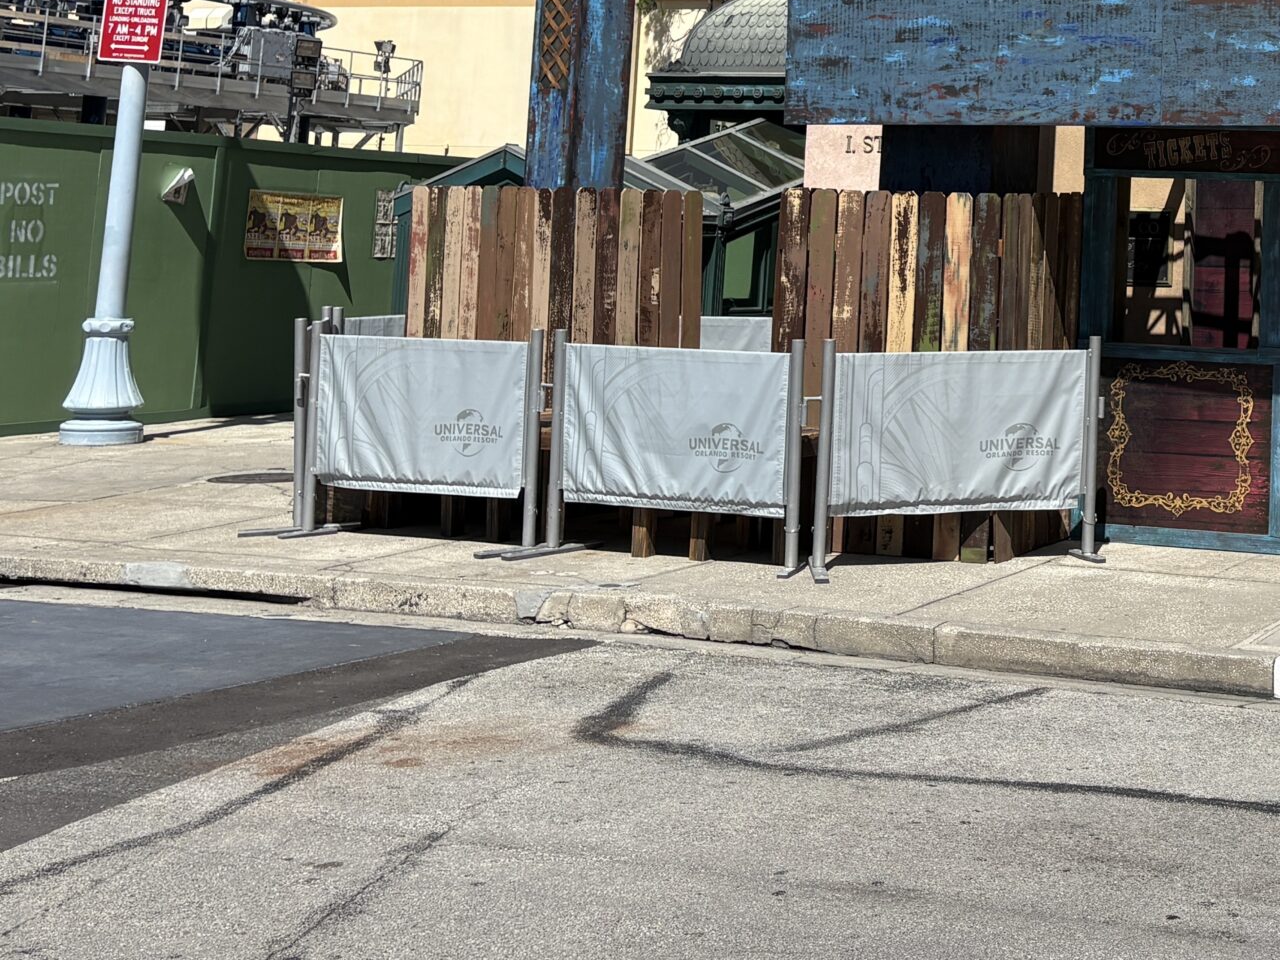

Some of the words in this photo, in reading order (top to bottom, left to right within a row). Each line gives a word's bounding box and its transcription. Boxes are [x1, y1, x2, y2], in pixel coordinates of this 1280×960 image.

[114, 6, 136, 14] EXCEPT
[137, 8, 156, 16] TRUCK
[108, 23, 114, 34] 7
[144, 25, 158, 36] PM
[113, 34, 130, 42] EXCEPT
[1143, 131, 1232, 169] TICKETS
[0, 182, 59, 205] POST
[10, 220, 44, 243] NO
[434, 423, 503, 438] UNIVERSAL
[473, 436, 498, 444] RESORT
[689, 437, 764, 454] UNIVERSAL
[980, 436, 1061, 452] UNIVERSAL
[695, 450, 728, 458] ORLANDO
[730, 451, 756, 460] RESORT
[986, 450, 1023, 459] ORLANDO
